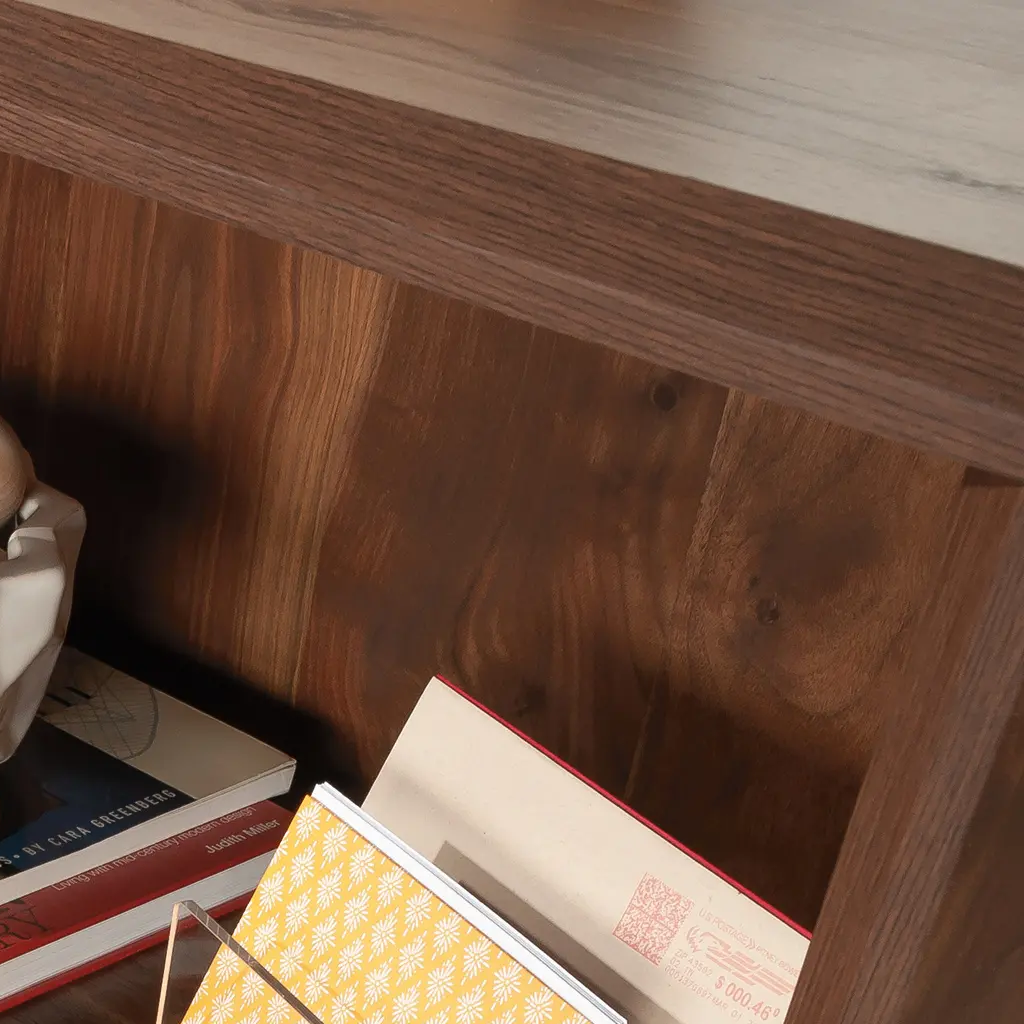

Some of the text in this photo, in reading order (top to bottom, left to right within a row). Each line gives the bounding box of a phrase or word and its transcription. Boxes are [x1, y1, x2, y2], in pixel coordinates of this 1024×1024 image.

[21, 840, 46, 857] BY
[47, 825, 92, 848] CARA
[90, 788, 177, 829] GREENBERG
[51, 872, 91, 892] Living
[90, 862, 114, 878] with
[177, 820, 222, 841] modern
[219, 806, 258, 828] design
[205, 818, 282, 855] Judith Miller
